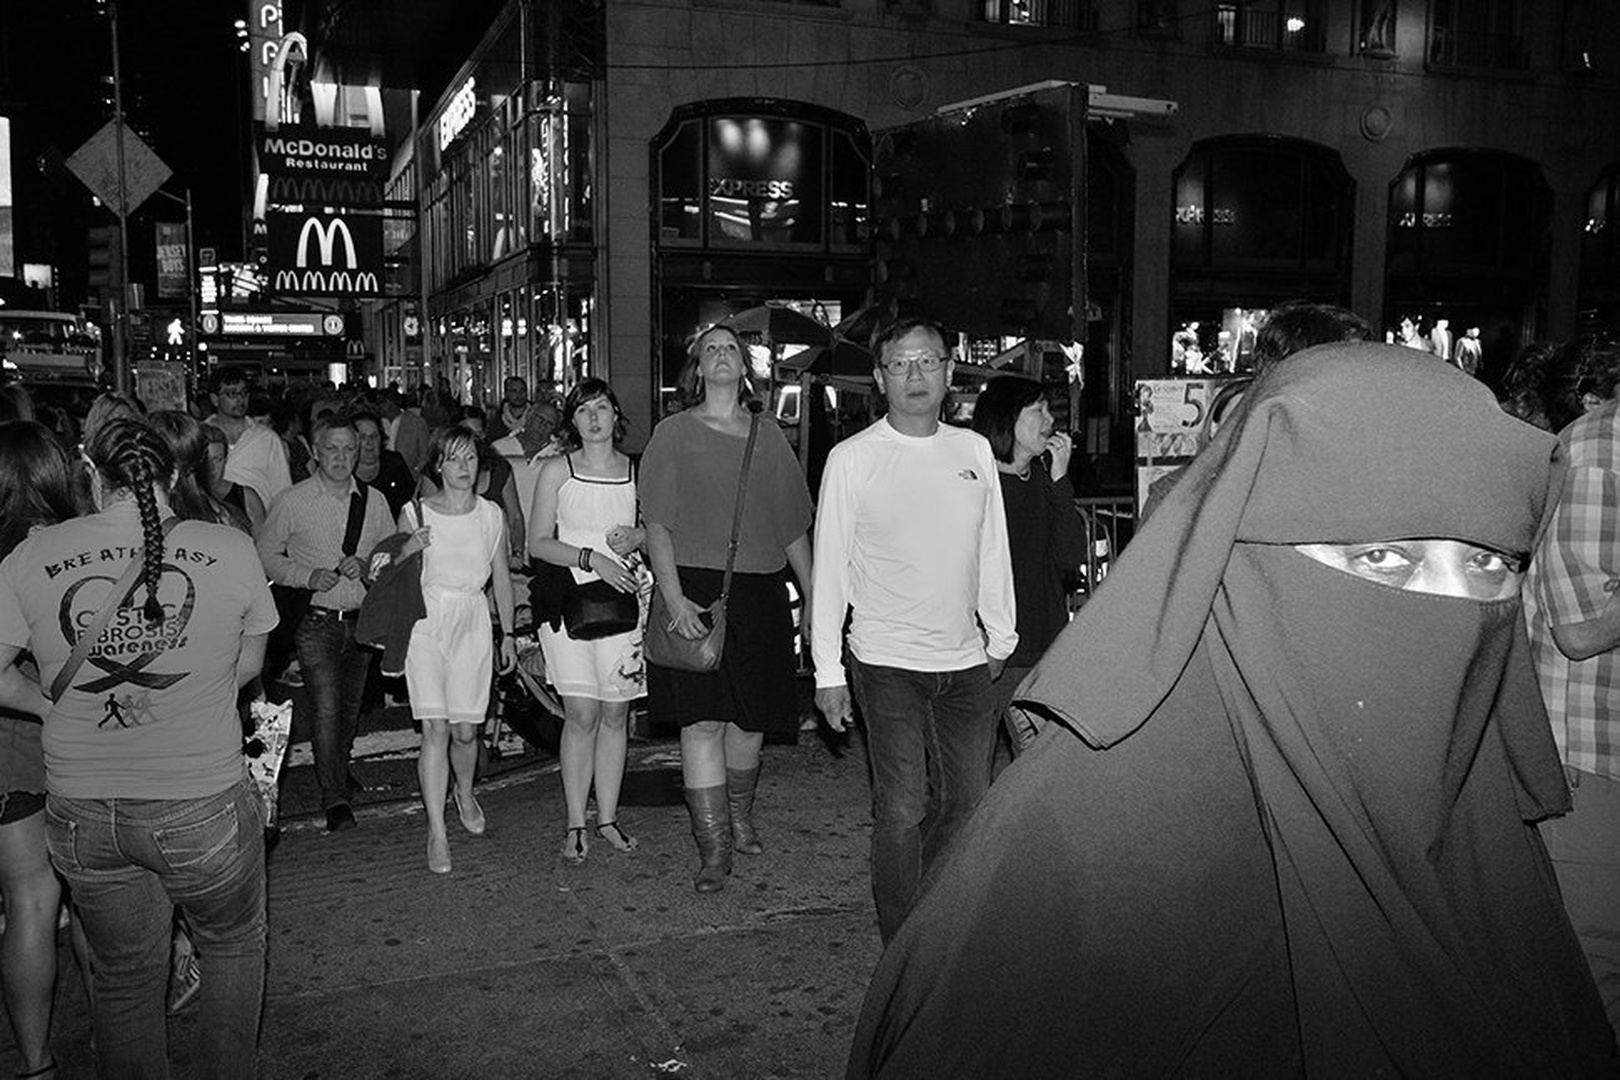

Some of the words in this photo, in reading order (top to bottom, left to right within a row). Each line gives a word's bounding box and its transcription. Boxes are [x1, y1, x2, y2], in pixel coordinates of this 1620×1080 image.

[264, 138, 388, 161] McDonald's
[285, 156, 368, 172] Restaurant
[76, 603, 178, 627] CSTC
[76, 621, 179, 644] FBROSIS
[88, 636, 189, 657] wareness
